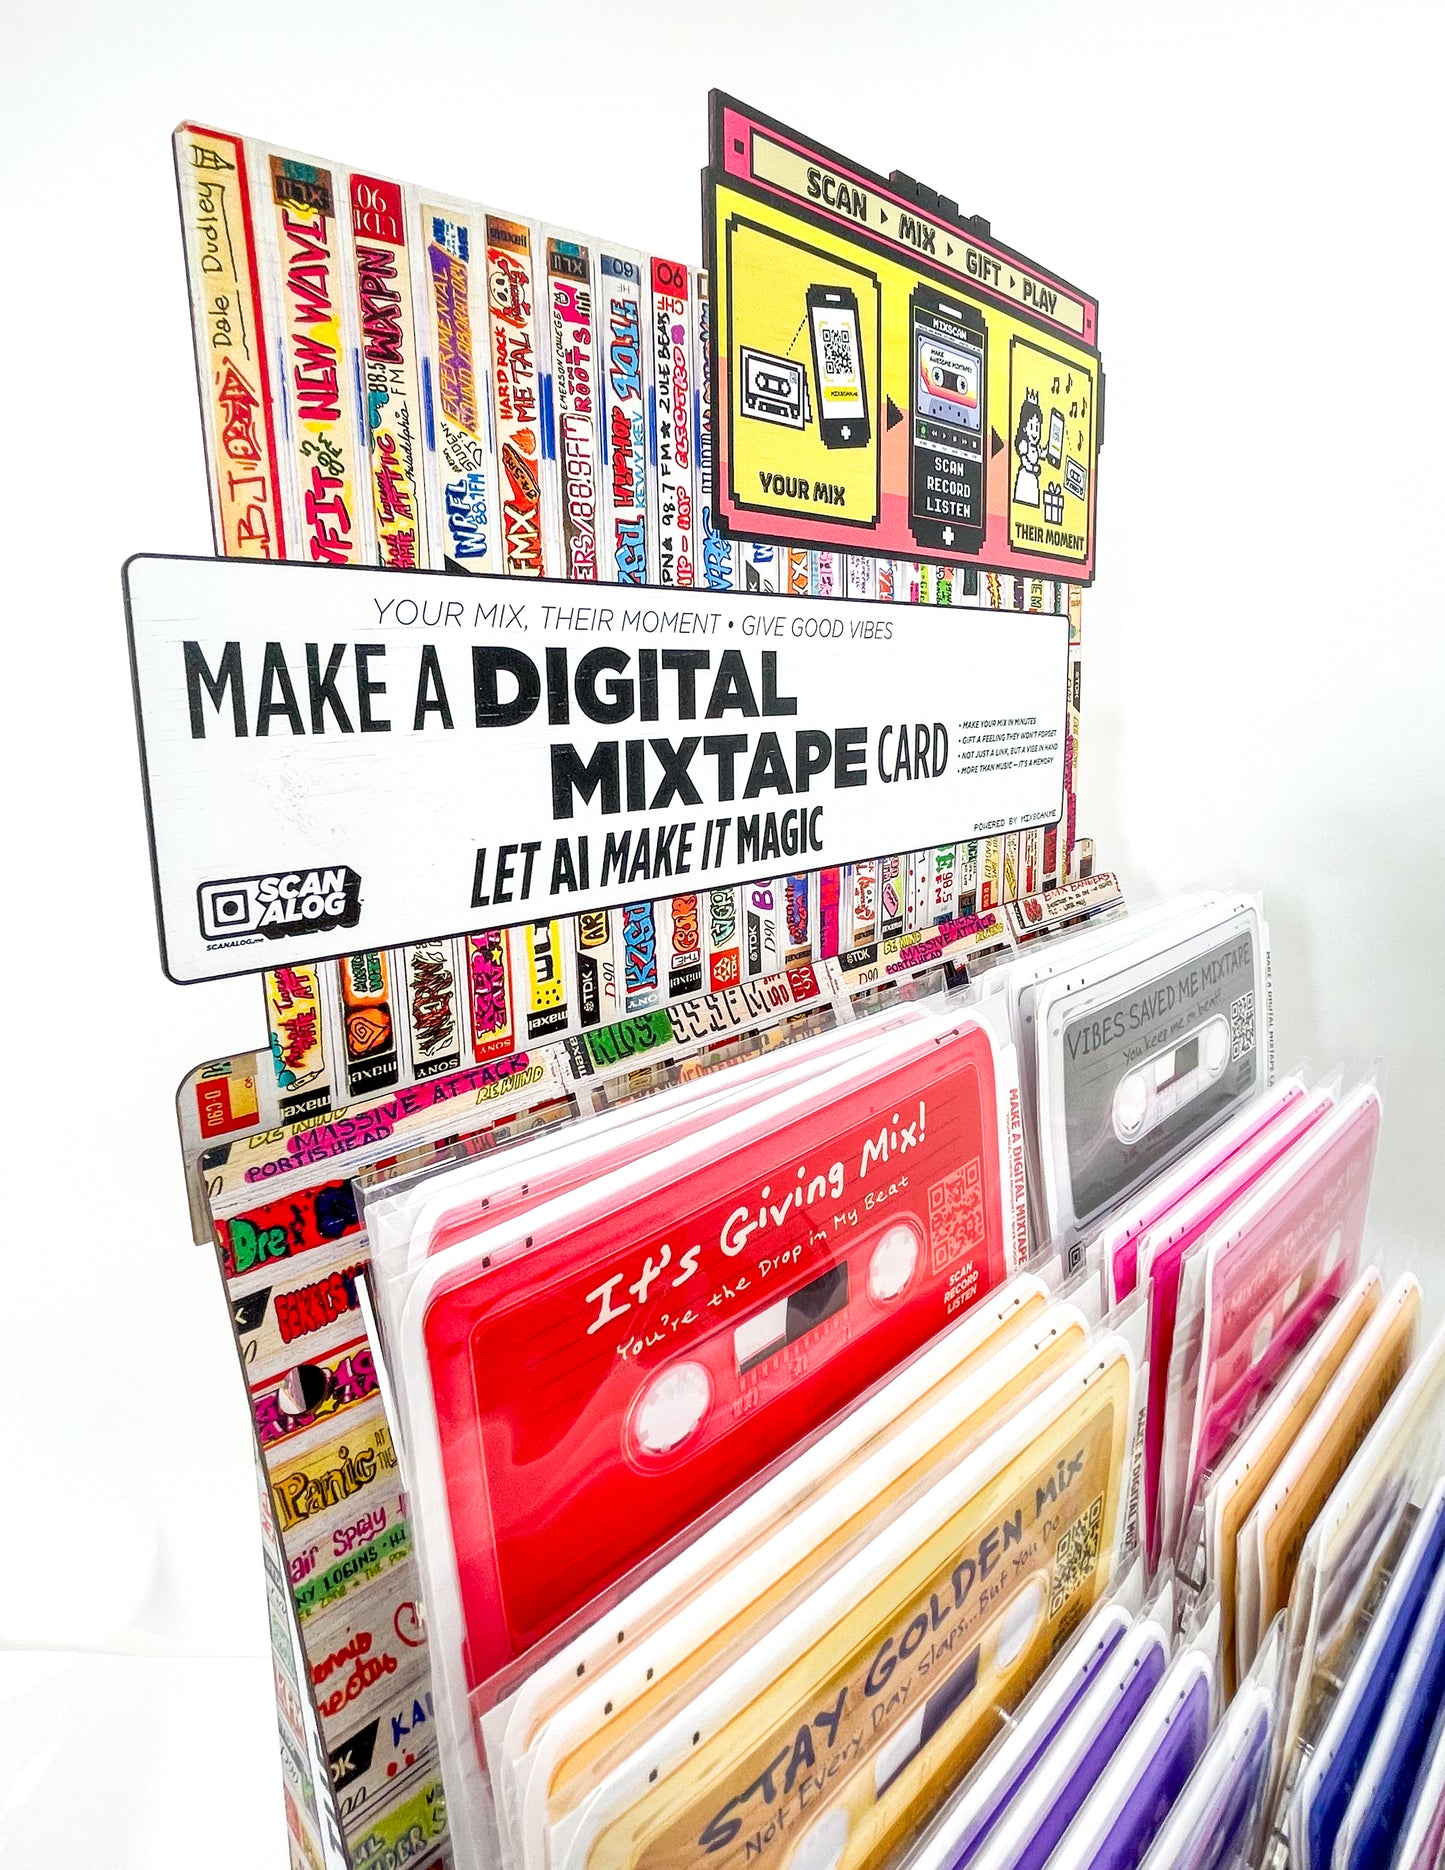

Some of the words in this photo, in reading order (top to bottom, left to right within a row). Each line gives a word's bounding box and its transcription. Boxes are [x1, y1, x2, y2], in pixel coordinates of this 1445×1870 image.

[197, 183, 224, 274] Dudley
[806, 167, 867, 222] SCAN
[899, 212, 936, 255] MIX
[966, 247, 1002, 288] GIFT
[1022, 277, 1058, 316] PLAY
[656, 263, 684, 290] 90
[213, 296, 232, 350] Dale
[356, 245, 404, 364] WXPN
[450, 262, 475, 368] LABORATORY
[657, 297, 685, 316] CHF
[432, 267, 458, 419] EXPERIMENTAL
[552, 311, 566, 358] COLLEGE
[932, 318, 967, 341] MIXSCAN
[294, 333, 341, 420] NEW
[367, 361, 389, 393] 88.5
[389, 369, 406, 398] FM
[508, 332, 537, 423] METAL
[556, 358, 569, 411] EMERSON
[572, 327, 593, 414] ROOTS
[498, 368, 513, 420] HARD
[672, 346, 690, 469] ELECTRO
[442, 421, 477, 471] STUDENT
[659, 444, 673, 477] FM
[934, 456, 964, 477] SCAN
[659, 483, 676, 527] 98.7
[758, 471, 809, 501] YOUR
[812, 477, 846, 506] MIX
[926, 474, 971, 499] RECORD
[926, 496, 971, 519] LISTEN
[444, 478, 489, 560] WRFL
[1014, 521, 1045, 543] THEIR
[1045, 527, 1085, 552] MOMENT
[374, 598, 464, 627] YOUR
[474, 602, 529, 632] MIX,
[541, 605, 614, 632] THEIR
[620, 609, 722, 635] MOMENT
[741, 614, 787, 638] GIVE
[791, 617, 845, 639] GOOD
[849, 617, 895, 641] VIBES
[182, 640, 392, 739] MAKE
[413, 643, 455, 731] A
[471, 645, 798, 729] DIGITAL
[962, 720, 980, 730] MAKE
[980, 719, 996, 729] YOUR
[997, 719, 1007, 728] MIX
[1014, 717, 1037, 726] MINUTES
[962, 735, 976, 745] GIFT
[982, 733, 1006, 743] FEELING
[1006, 732, 1020, 741] THEY
[1037, 729, 1058, 738] FORGET
[550, 726, 868, 820] MIXTAPE
[877, 722, 949, 784] CARD
[961, 750, 975, 760] NOT
[975, 749, 990, 759] JUST
[1010, 746, 1021, 755] BUT
[1026, 744, 1038, 753] VIBE
[1044, 742, 1059, 751] HAND
[961, 765, 979, 775] MORE
[979, 763, 995, 773] THAN
[995, 761, 1013, 771] MUSIC
[1032, 756, 1055, 767] MEMORY
[973, 817, 1006, 832] POWERED
[1008, 816, 1018, 825] BY
[470, 840, 542, 909] LET
[549, 835, 590, 896] AI
[600, 821, 697, 887] MAKE
[700, 817, 732, 871] IT
[737, 805, 824, 865] MAGIC
[256, 868, 346, 902] SCAN
[256, 891, 346, 927] ALOG
[749, 924, 759, 955] TDK
[763, 919, 776, 953] D90
[851, 948, 870, 964] TDK
[900, 934, 951, 960] MASSIVE
[948, 916, 996, 943] ATTACK
[582, 970, 595, 1000] TDK
[730, 955, 739, 979] TDK
[885, 951, 943, 975] PORTISHEAD
[1066, 1010, 1125, 1060] VIBES
[1129, 984, 1177, 1031] SAVED
[1177, 970, 1198, 1000] ME
[1200, 941, 1252, 988] MIXTAPE
[479, 1039, 512, 1055] SONY
[1122, 1043, 1143, 1067] You
[1143, 1027, 1168, 1052] keep
[1168, 1020, 1185, 1038] me
[1185, 1012, 1196, 1024] on
[418, 1059, 459, 1078] SONY
[247, 1124, 394, 1182] PORTISHEAD
[476, 1064, 544, 1105] REWIND
[293, 1092, 420, 1150] MASSIVE
[432, 1053, 529, 1103] ATTACK
[1009, 1088, 1020, 1129] MAKE
[1012, 1133, 1021, 1143] A
[1012, 1145, 1025, 1200] DIGITAL
[585, 1243, 701, 1337] It's
[719, 1161, 845, 1258] Giving
[859, 1100, 927, 1178] Mix!
[1015, 1203, 1029, 1266] MIXTAPE
[616, 1308, 699, 1361] You're
[706, 1275, 752, 1308] the
[758, 1244, 802, 1278] Drop
[808, 1228, 827, 1247] in
[833, 1207, 858, 1231] My
[864, 1174, 910, 1212] Beat
[943, 1268, 980, 1306] RECORD
[948, 1260, 974, 1287] SCAN
[946, 1285, 979, 1315] LISTEN
[271, 1442, 376, 1533] Panic
[331, 1505, 387, 1558] Spray
[324, 1547, 379, 1594] LOGINS
[697, 1685, 850, 1855] STAY
[864, 1509, 1023, 1699] GOLDEN
[1034, 1448, 1085, 1519] Mix
[743, 1806, 786, 1861] Not
[796, 1738, 864, 1809] Every
[870, 1676, 914, 1727] Day
[977, 1568, 1010, 1617] But
[1011, 1541, 1039, 1578] You
[1041, 1513, 1063, 1544] Do
